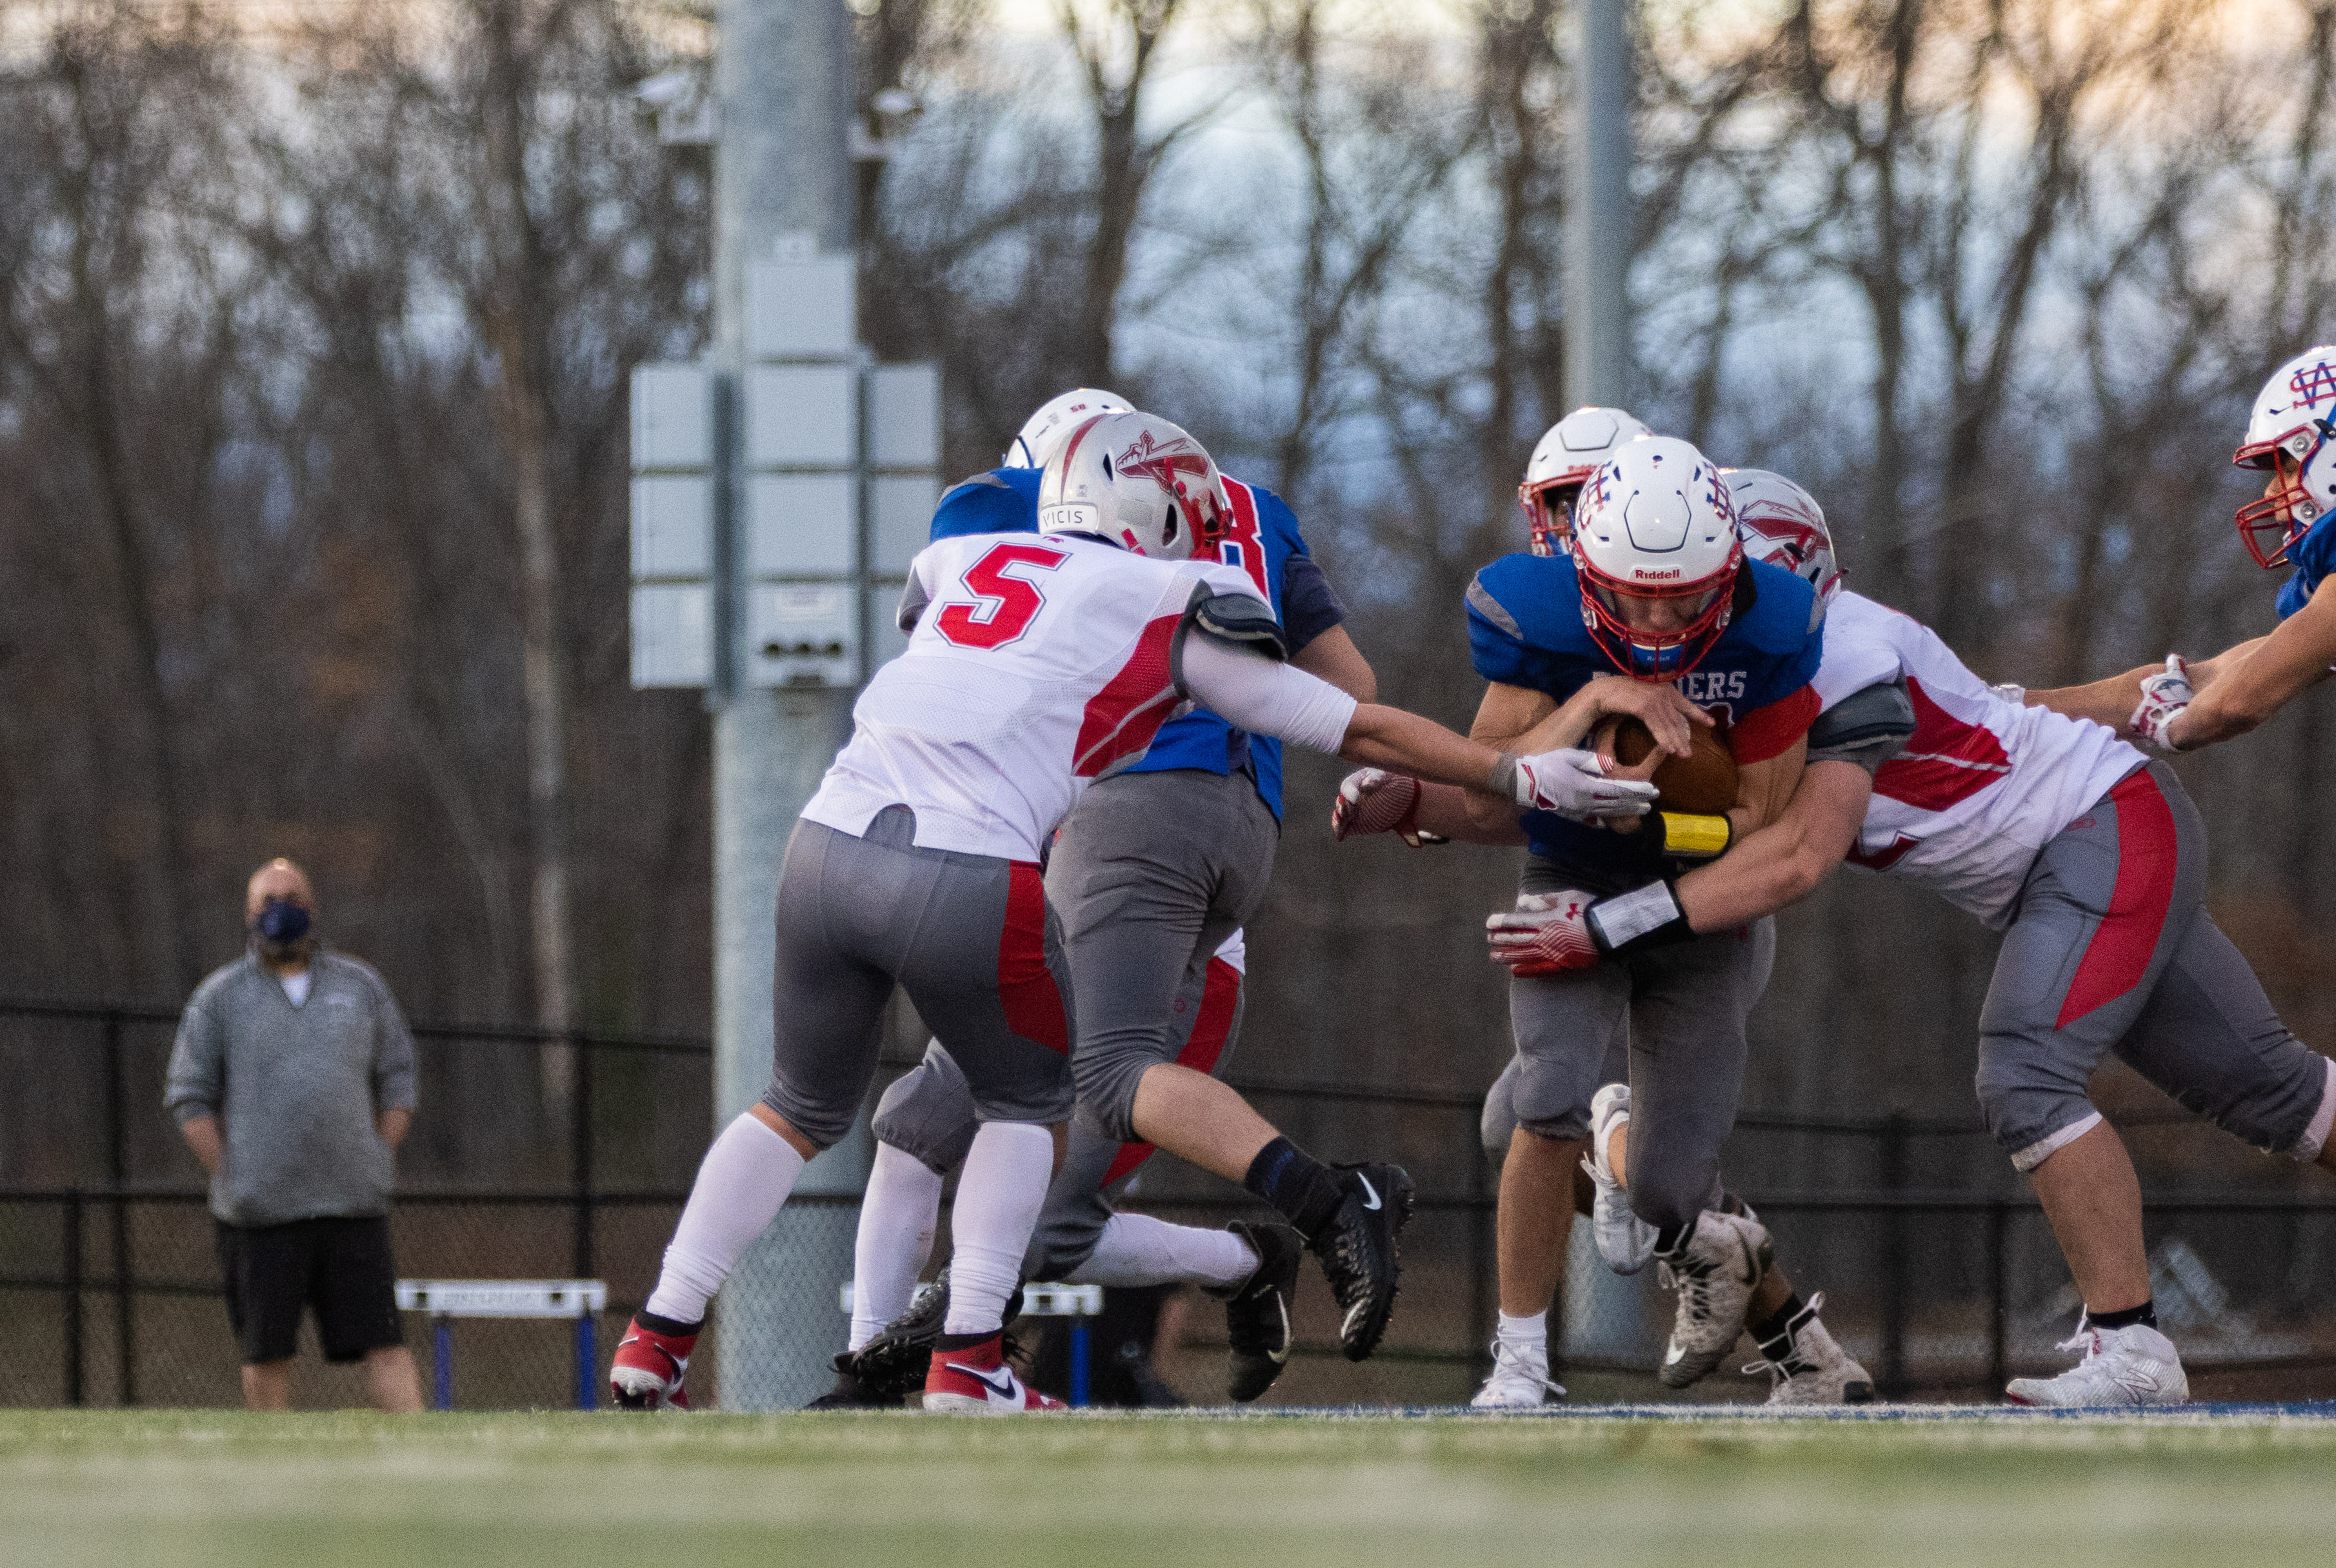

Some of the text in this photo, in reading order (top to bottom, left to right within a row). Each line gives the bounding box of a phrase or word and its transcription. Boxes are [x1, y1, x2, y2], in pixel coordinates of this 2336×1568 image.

[1043, 510, 1083, 528] VICIS
[1635, 569, 1680, 579] Riddell
[932, 540, 1074, 653] 5
